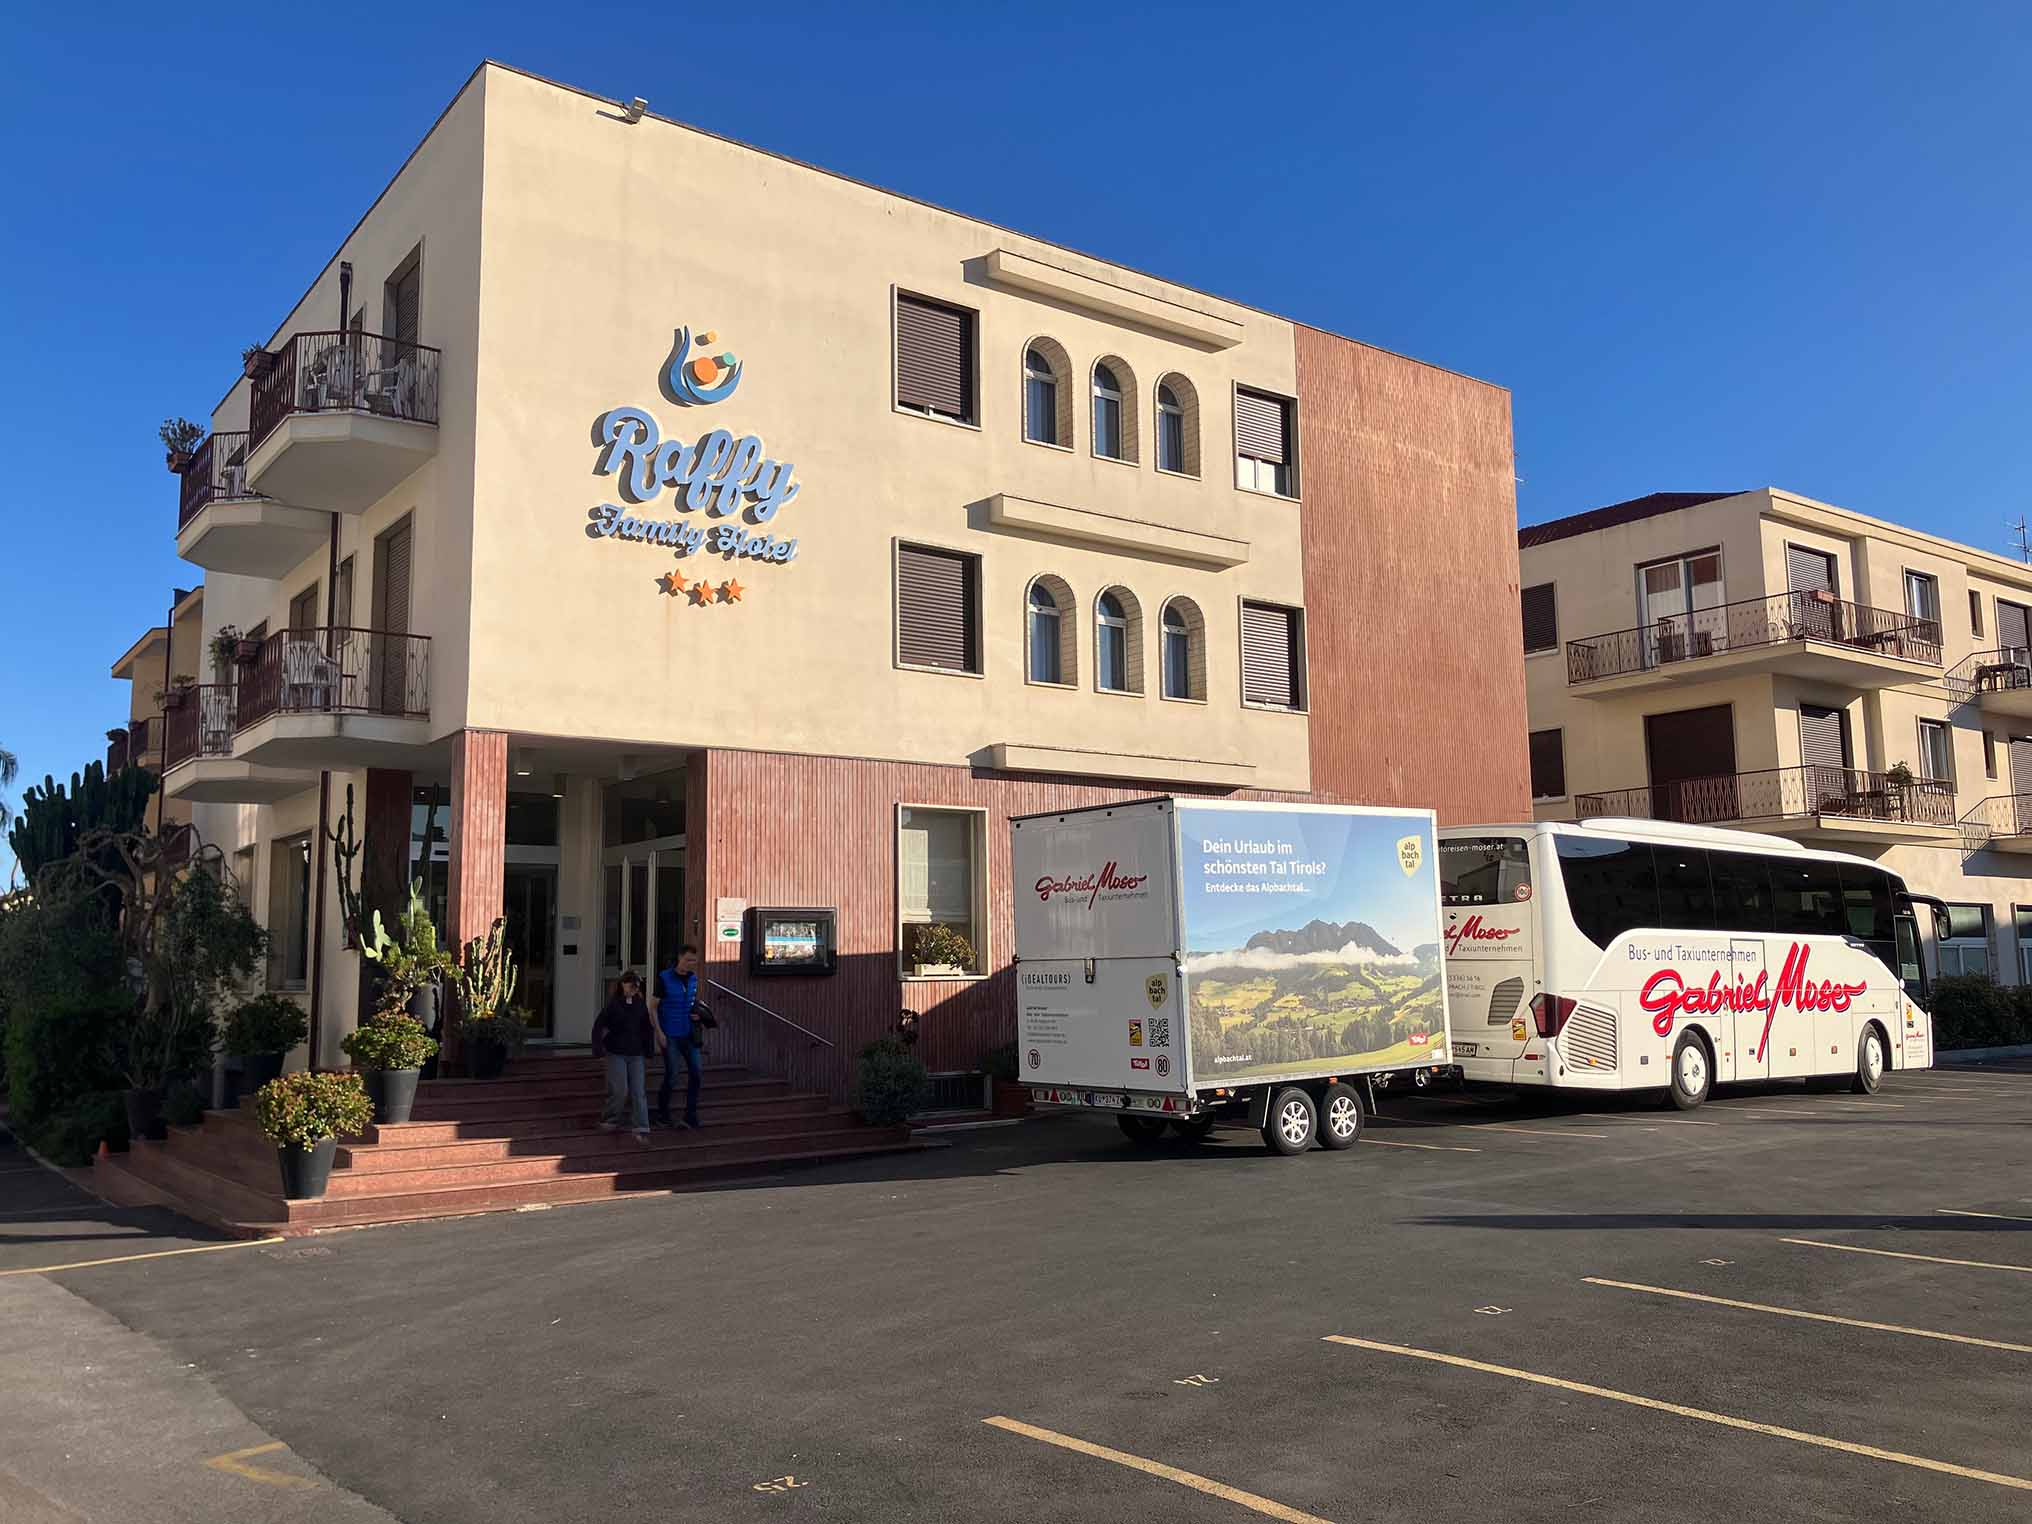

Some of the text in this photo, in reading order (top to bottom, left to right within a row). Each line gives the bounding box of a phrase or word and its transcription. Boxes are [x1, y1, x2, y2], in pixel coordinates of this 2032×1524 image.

[600, 405, 801, 523] Raffy
[599, 502, 798, 562] Family Hotel
[1203, 838, 1293, 855] Dein Urlaub im
[1404, 841, 1416, 851] alp
[1401, 850, 1420, 860] bach
[1203, 859, 1327, 875] schönsten Tal Tirols?
[1404, 860, 1415, 869] tal
[1035, 861, 1148, 911] Gabriel Moser
[1205, 882, 1245, 893] Entdecke
[1246, 882, 1260, 893] das
[1448, 914, 1521, 956] Moser
[1628, 943, 1757, 963] Bus- und Taxiunternehmen
[1149, 986, 1166, 994] bach
[1151, 979, 1163, 987] alp
[1639, 941, 1867, 1064] Gabriel Moser
[1030, 1052, 1039, 1065] 70
[1157, 1058, 1168, 1073] 80
[1214, 1054, 1252, 1065] alpbachtal.at
